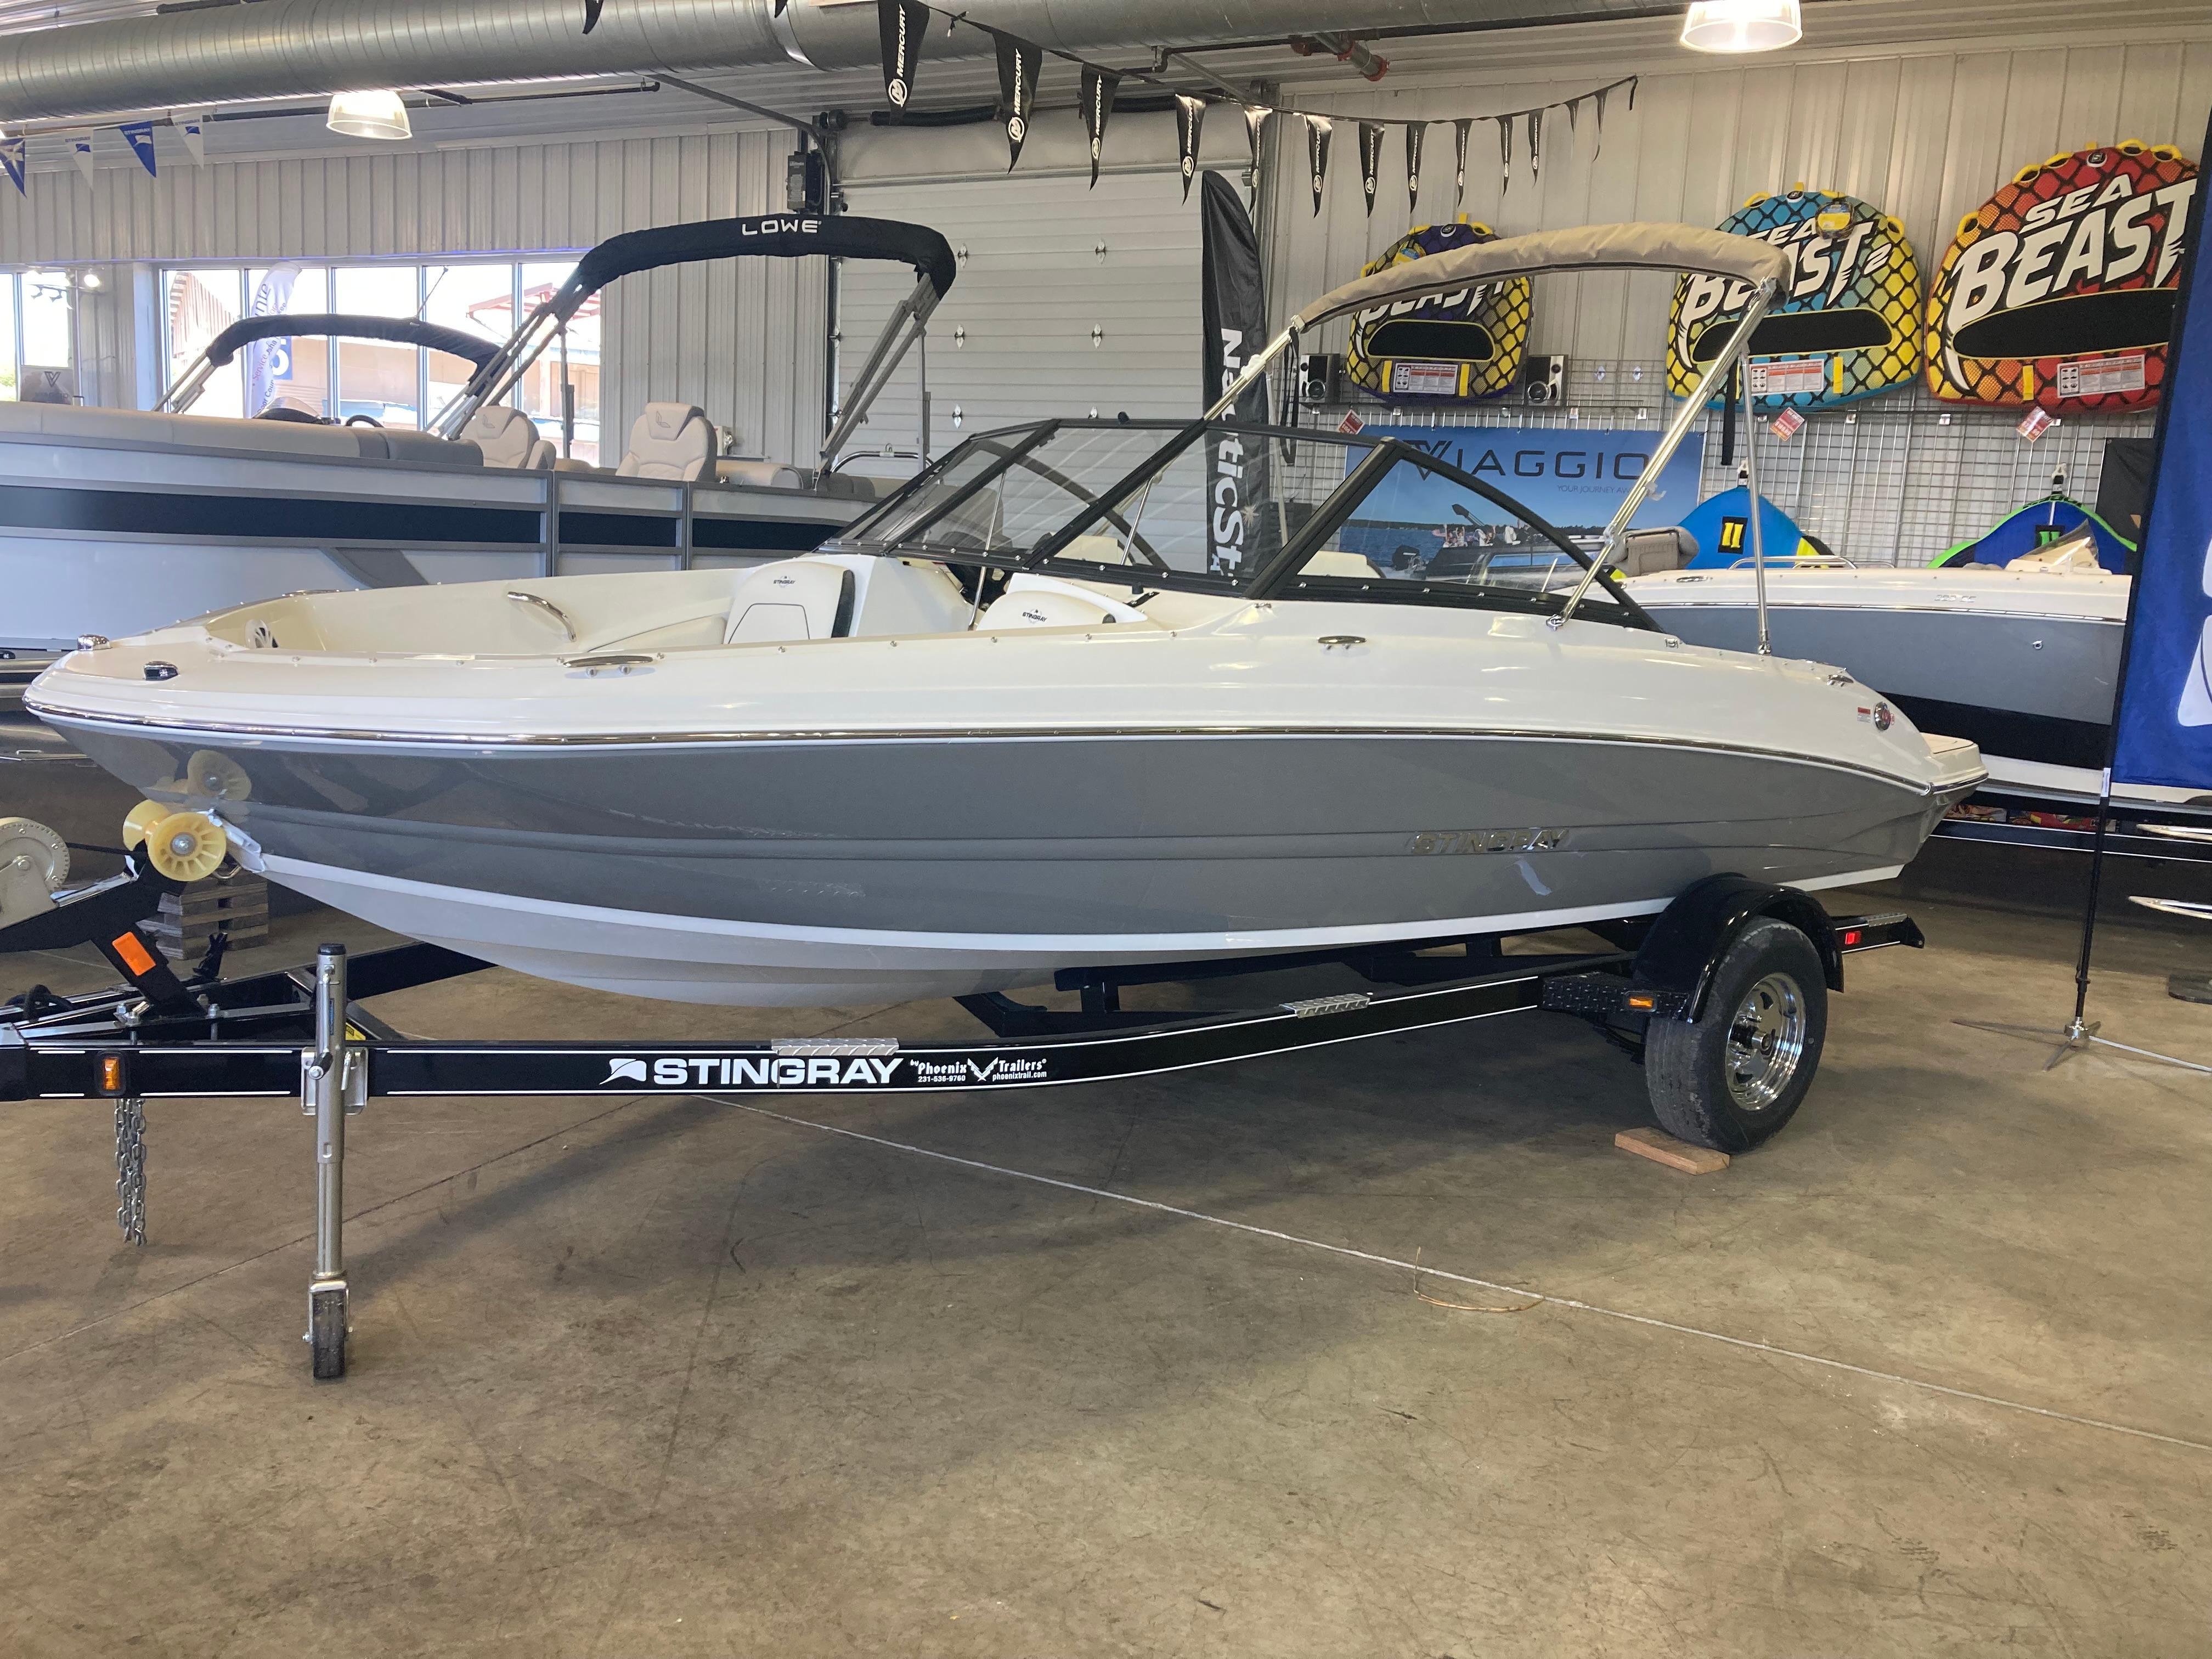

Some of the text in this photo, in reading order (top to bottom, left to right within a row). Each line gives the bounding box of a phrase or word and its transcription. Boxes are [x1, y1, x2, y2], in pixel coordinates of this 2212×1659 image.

[896, 3, 906, 77] MERCURY
[2019, 174, 2132, 234] SEA
[742, 219, 819, 236] LOWE
[1748, 217, 1816, 245] EA
[1677, 222, 1892, 368] BST 2
[1942, 178, 2197, 390] BEAST
[1402, 440, 1650, 481] VIAGGIO
[1579, 486, 1615, 494] JOURNEY
[1412, 828, 1568, 854] STINGRAY
[653, 1058, 904, 1085] STINGRAY
[917, 1062, 967, 1075] Phoenix
